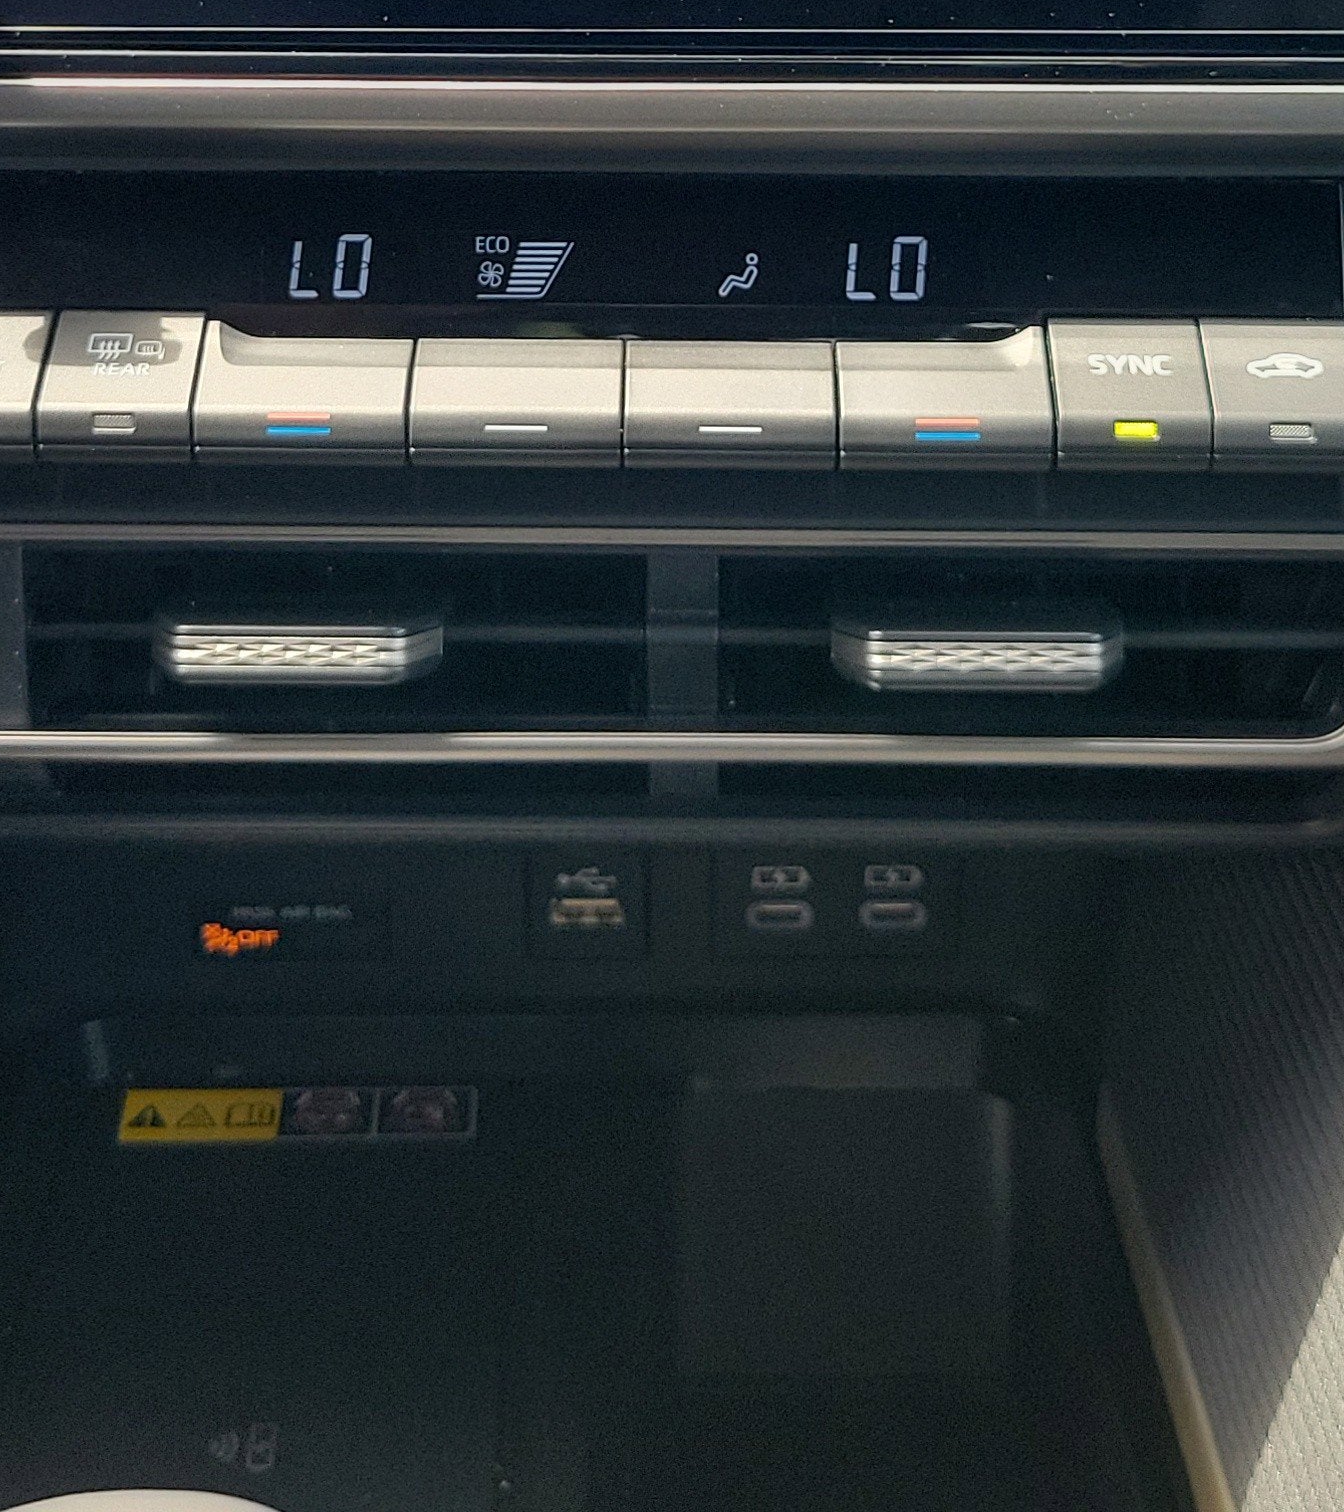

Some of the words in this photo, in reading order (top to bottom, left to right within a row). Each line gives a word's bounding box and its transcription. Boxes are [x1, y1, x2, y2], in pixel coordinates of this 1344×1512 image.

[474, 235, 510, 253] ECO
[93, 362, 151, 376] REAR
[1087, 352, 1174, 377] SYNC
[236, 929, 280, 948] OFF
